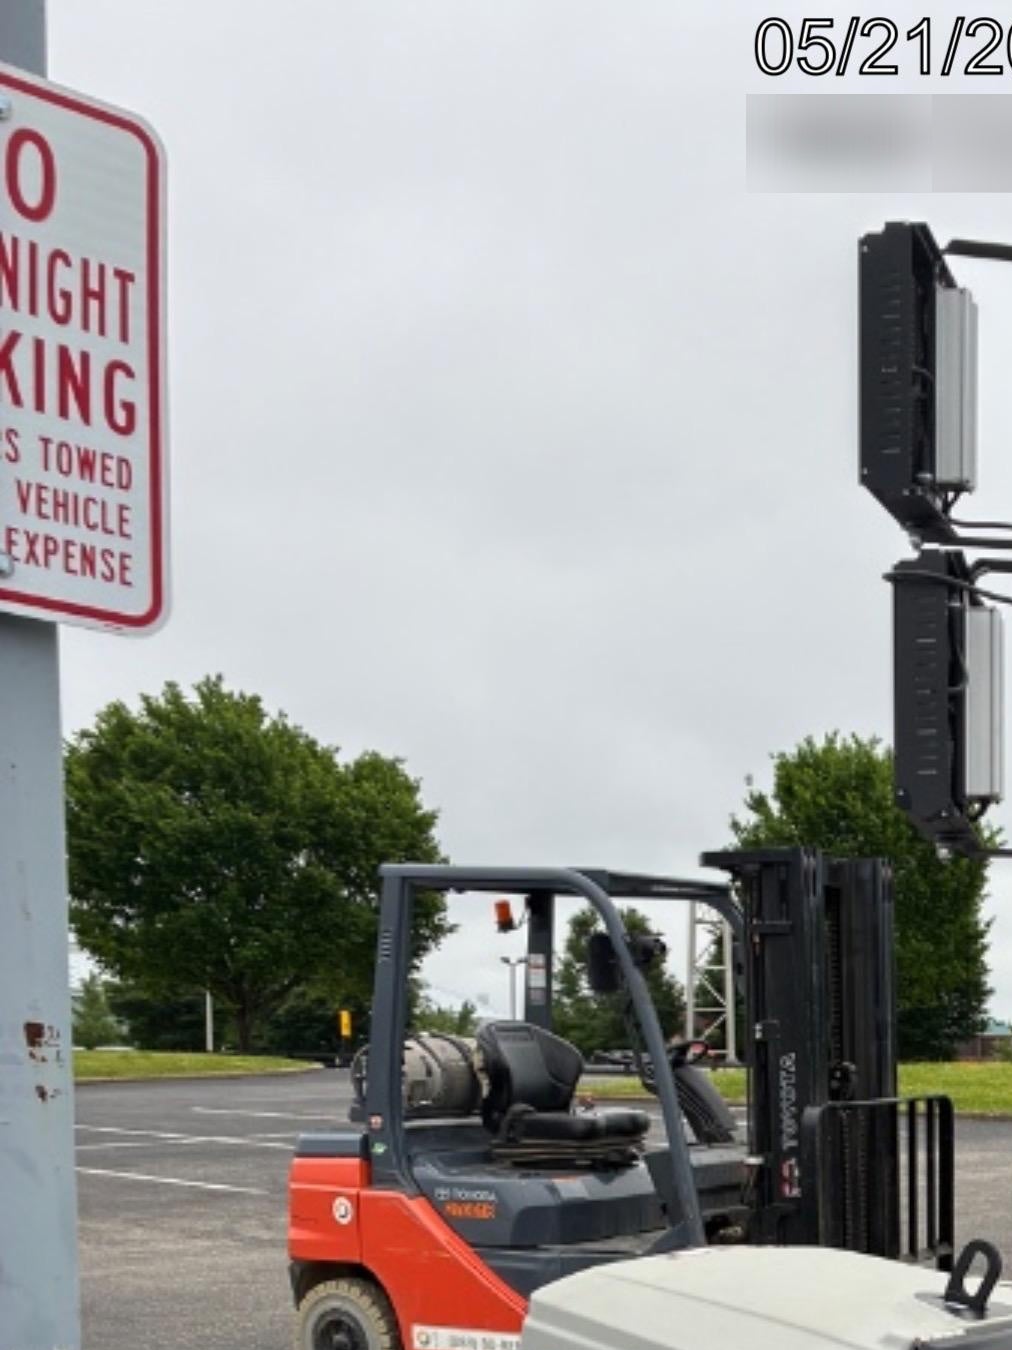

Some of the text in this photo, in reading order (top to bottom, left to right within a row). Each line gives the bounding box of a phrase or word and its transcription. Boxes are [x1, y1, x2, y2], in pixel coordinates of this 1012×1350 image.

[0, 234, 135, 345] NIGHT
[39, 437, 132, 490] TOWED
[16, 479, 132, 539] VEHICLE
[5, 527, 133, 587] EXPENSE
